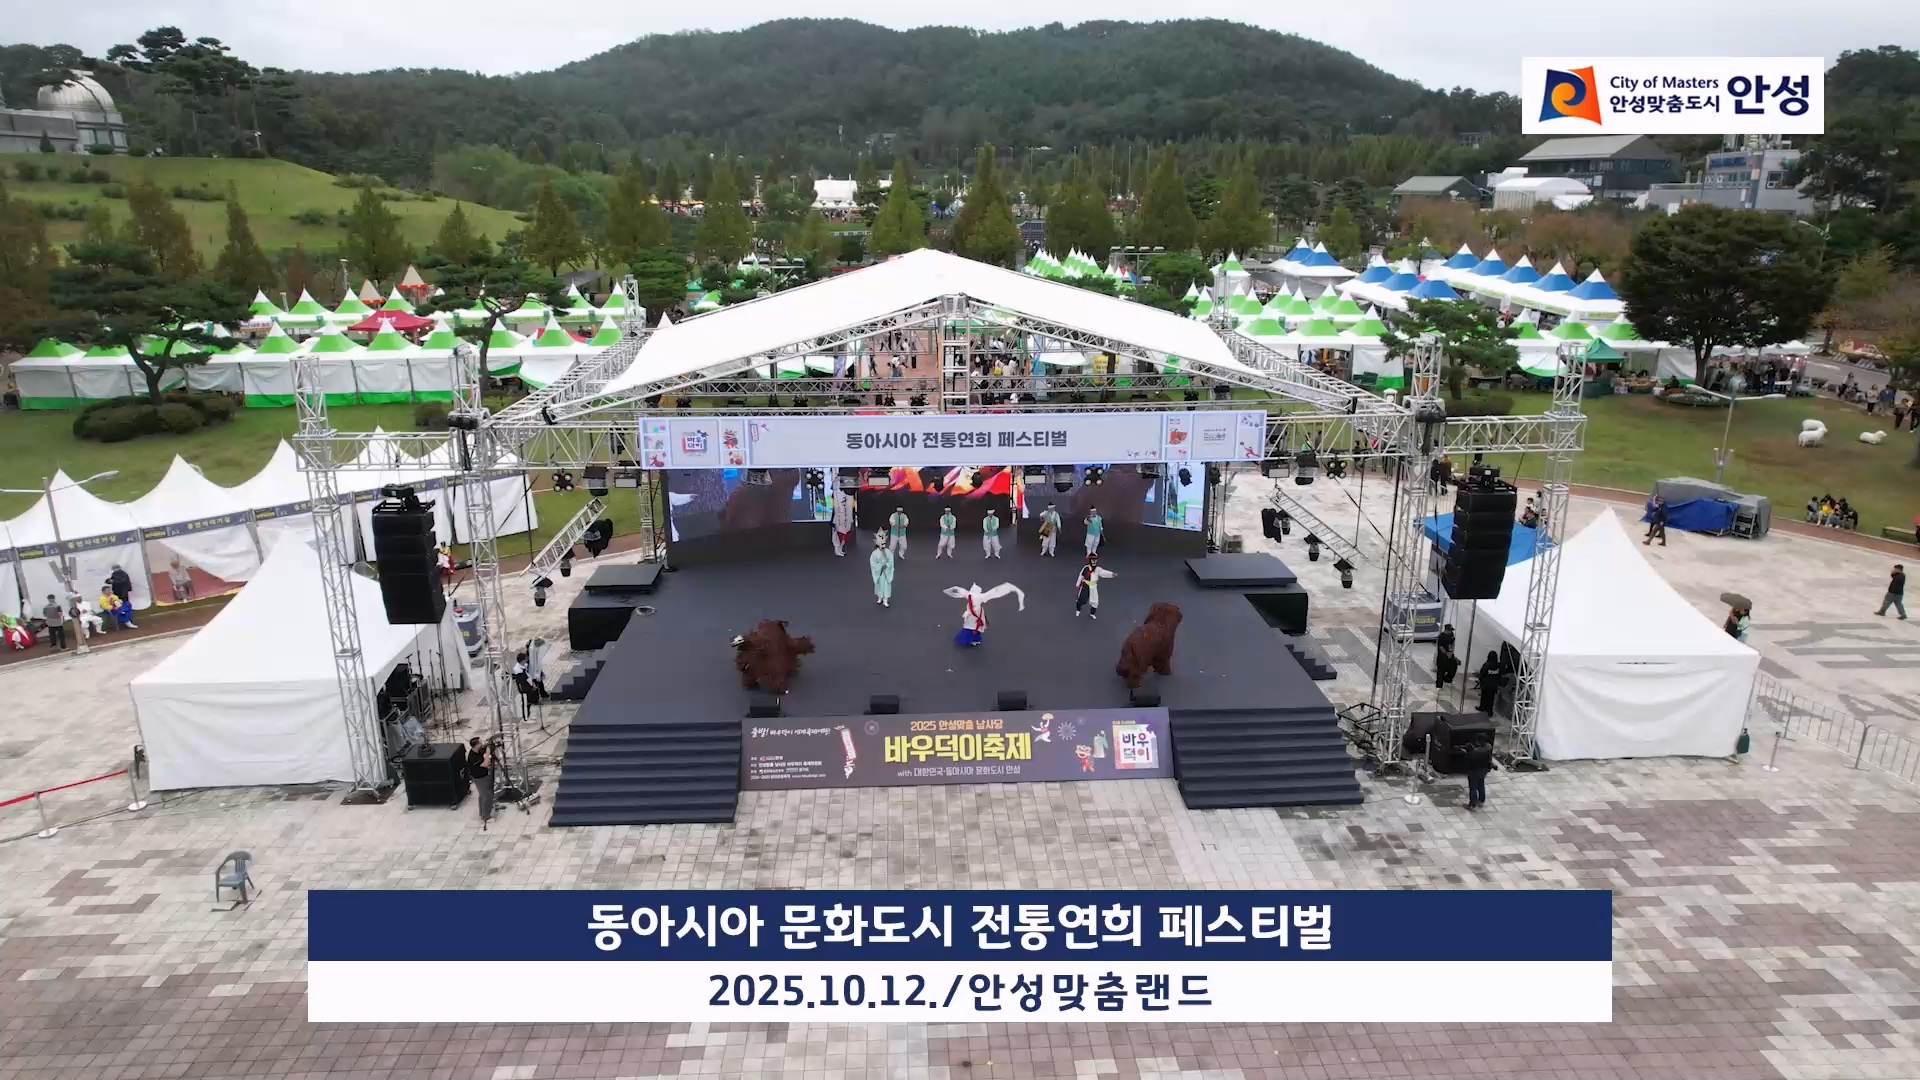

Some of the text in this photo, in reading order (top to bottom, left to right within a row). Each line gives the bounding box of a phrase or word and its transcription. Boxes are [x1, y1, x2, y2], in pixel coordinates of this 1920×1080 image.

[846, 430, 1067, 450] 동아시아 전통연희 페스티벌
[910, 719, 1003, 731] 2025 안성맞춤 남사당
[1122, 732, 1149, 747] 바우
[884, 732, 1032, 763] 바우덕이축제
[1123, 747, 1149, 761] 덕이
[897, 769, 912, 777] with
[975, 765, 1004, 775] 문화도시
[1005, 765, 1021, 775] 안성
